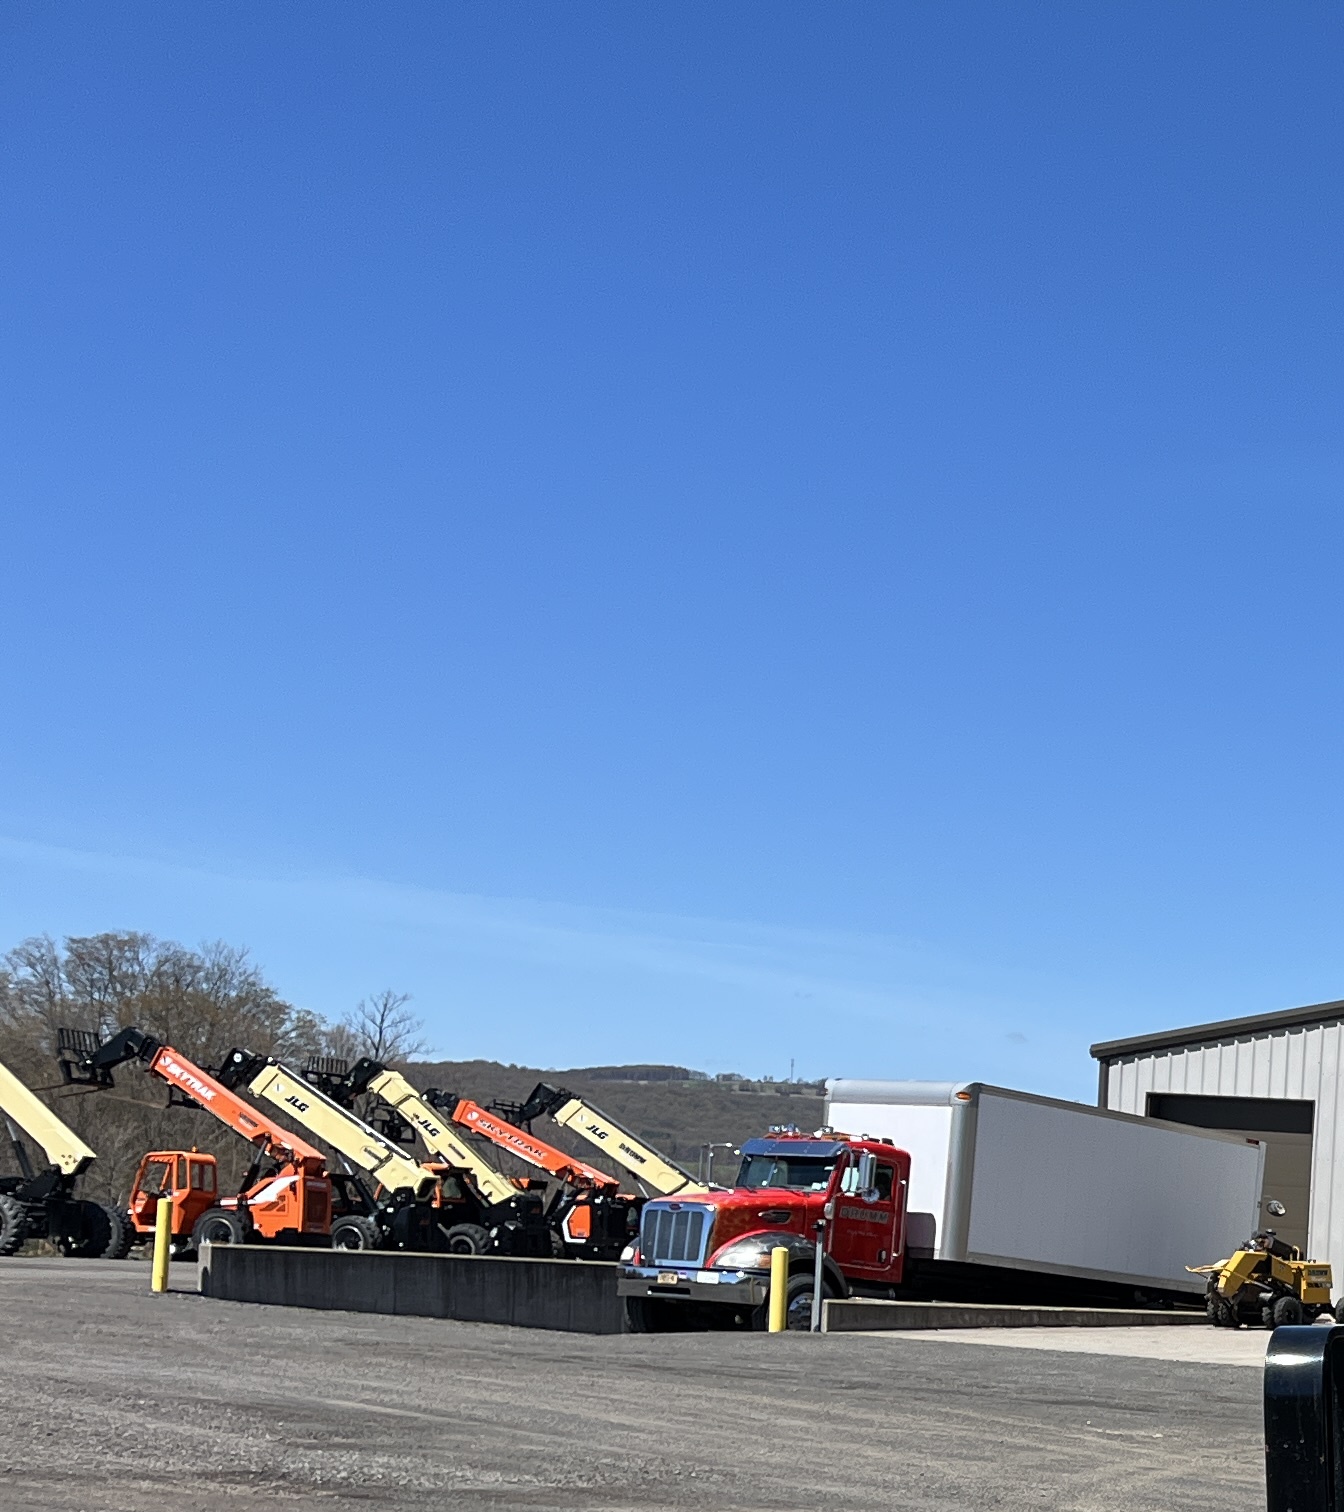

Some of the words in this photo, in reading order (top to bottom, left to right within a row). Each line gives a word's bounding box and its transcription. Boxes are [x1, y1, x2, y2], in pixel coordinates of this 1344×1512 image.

[166, 1063, 218, 1102] SKYTRAK
[284, 1095, 310, 1113] JLG
[417, 1119, 441, 1138] JLG
[585, 1124, 609, 1140] JLG
[476, 1118, 550, 1160] SKYTRAK
